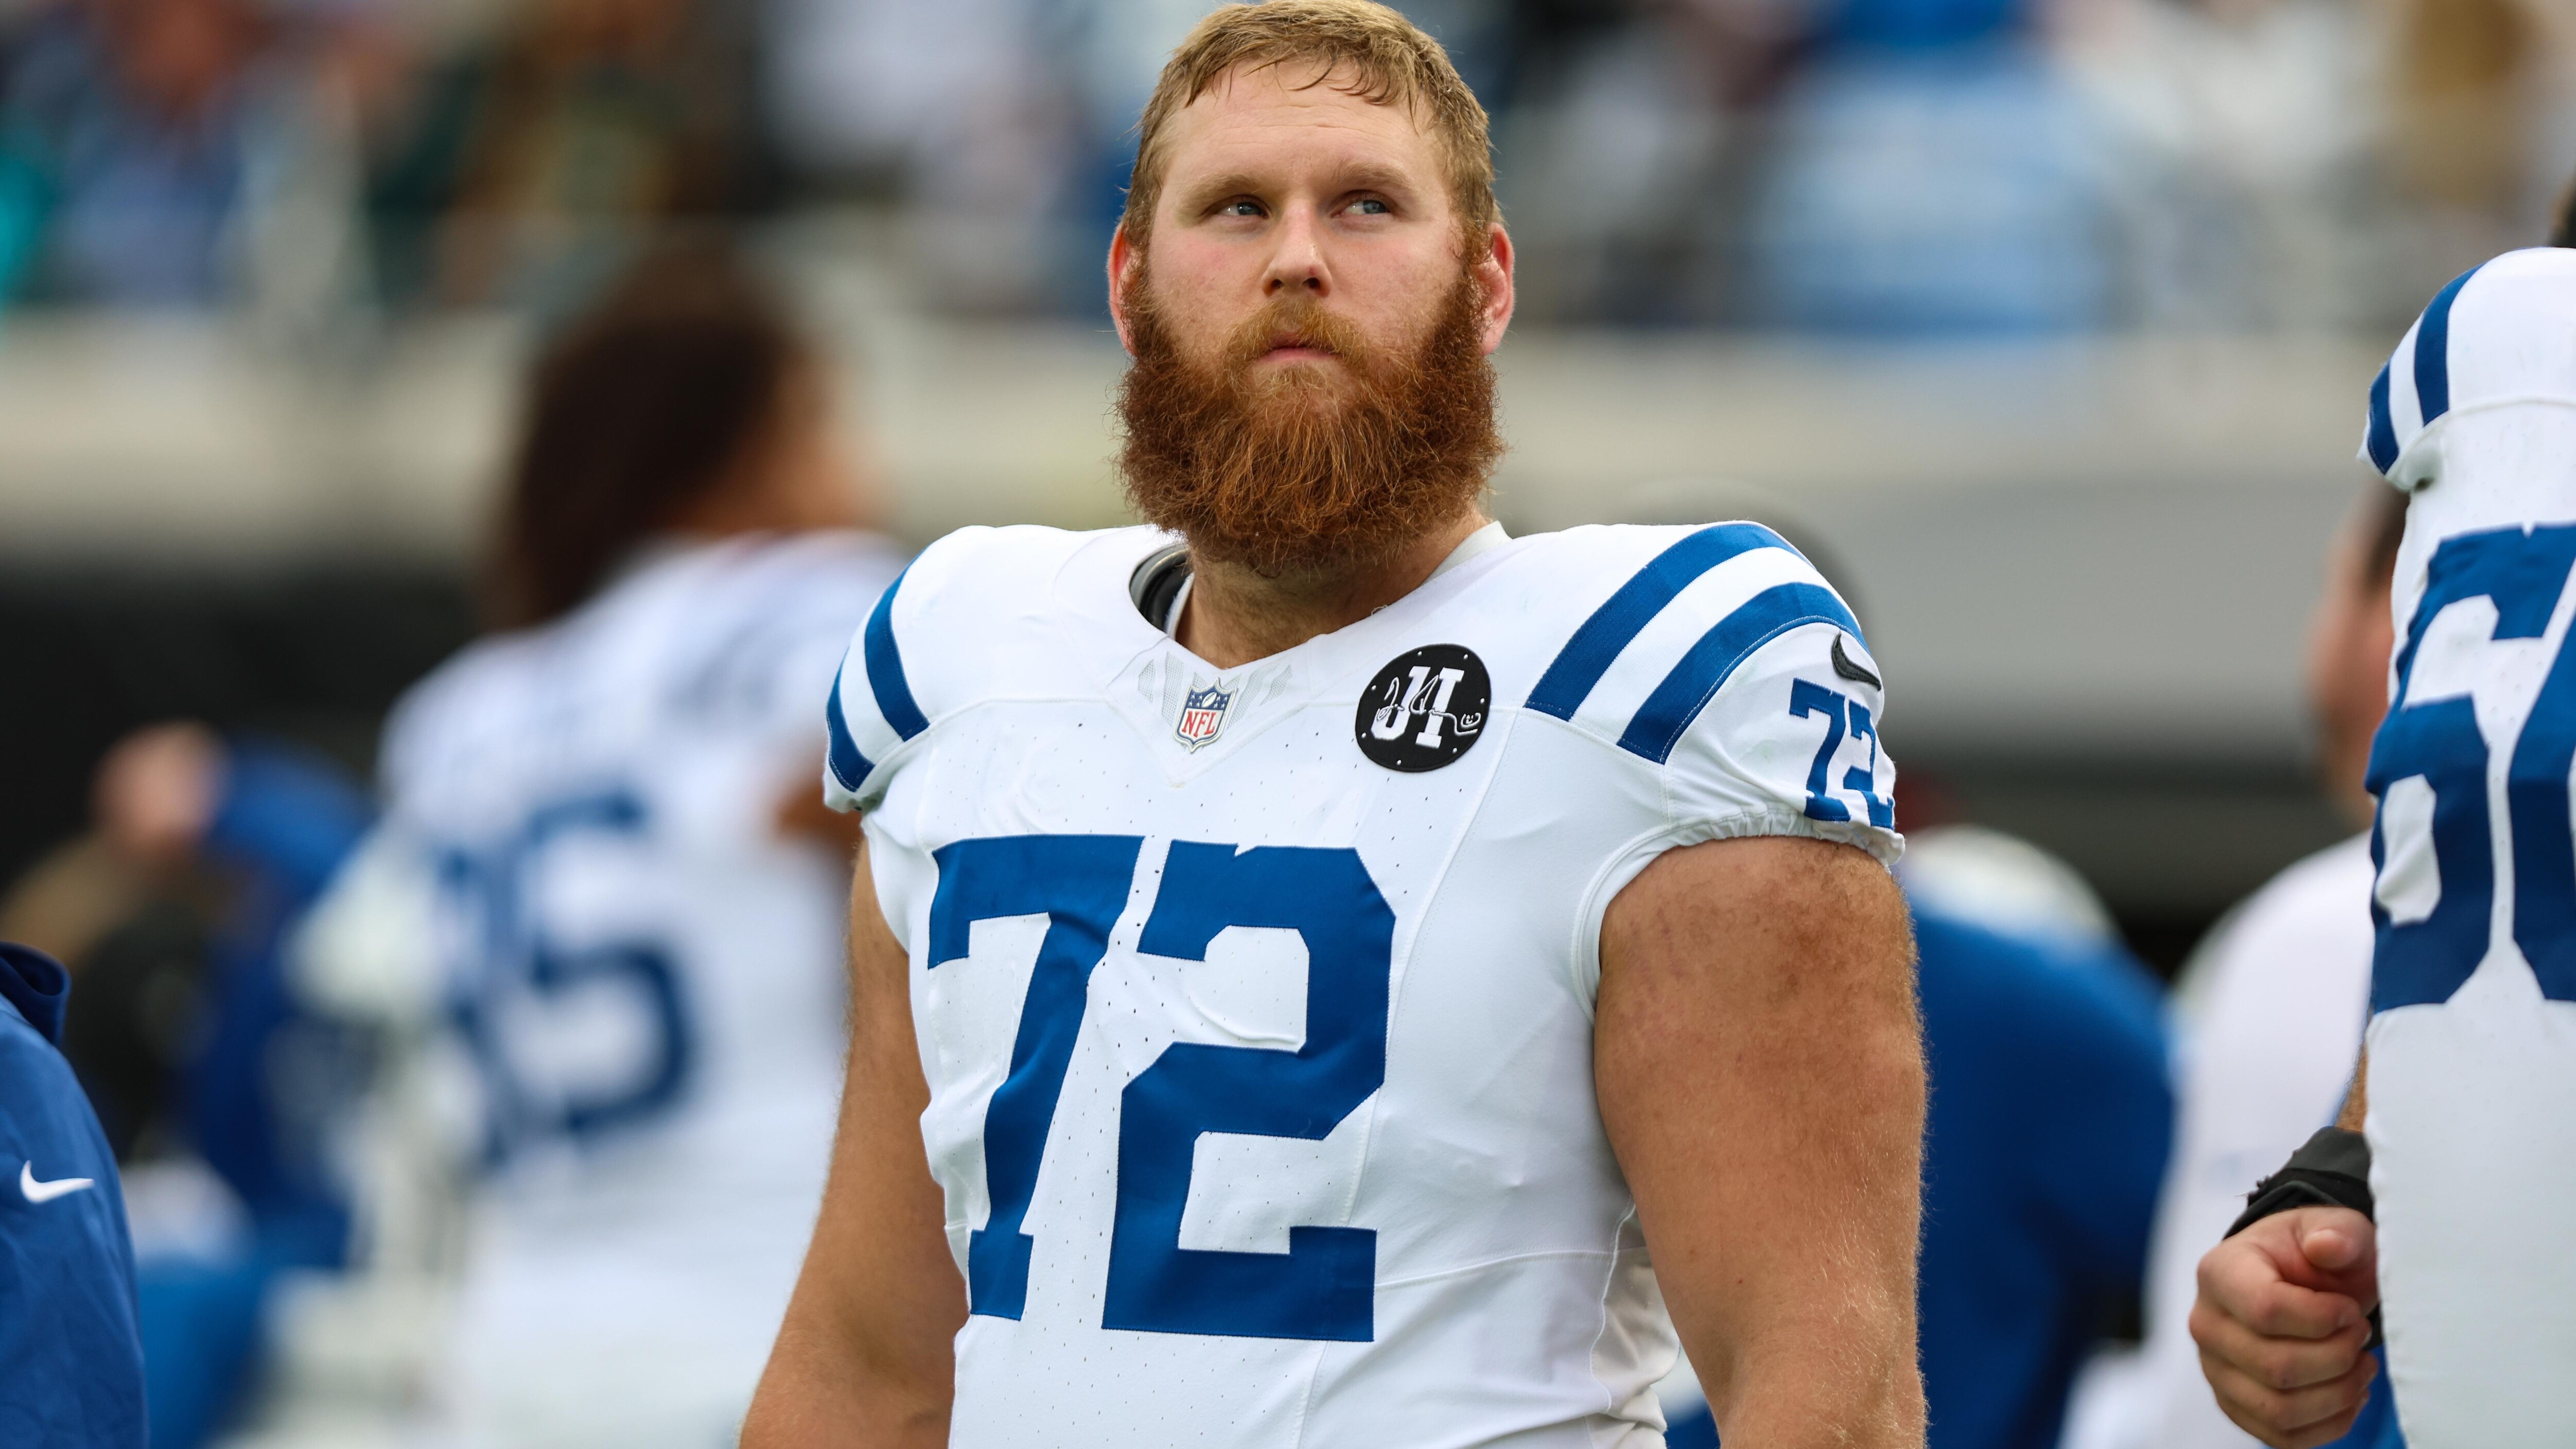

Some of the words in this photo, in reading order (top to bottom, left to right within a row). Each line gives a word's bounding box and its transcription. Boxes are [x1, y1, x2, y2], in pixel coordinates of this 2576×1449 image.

[1182, 710, 1217, 738] NFL
[1789, 677, 1894, 830] 72
[928, 834, 1395, 1341] 72
